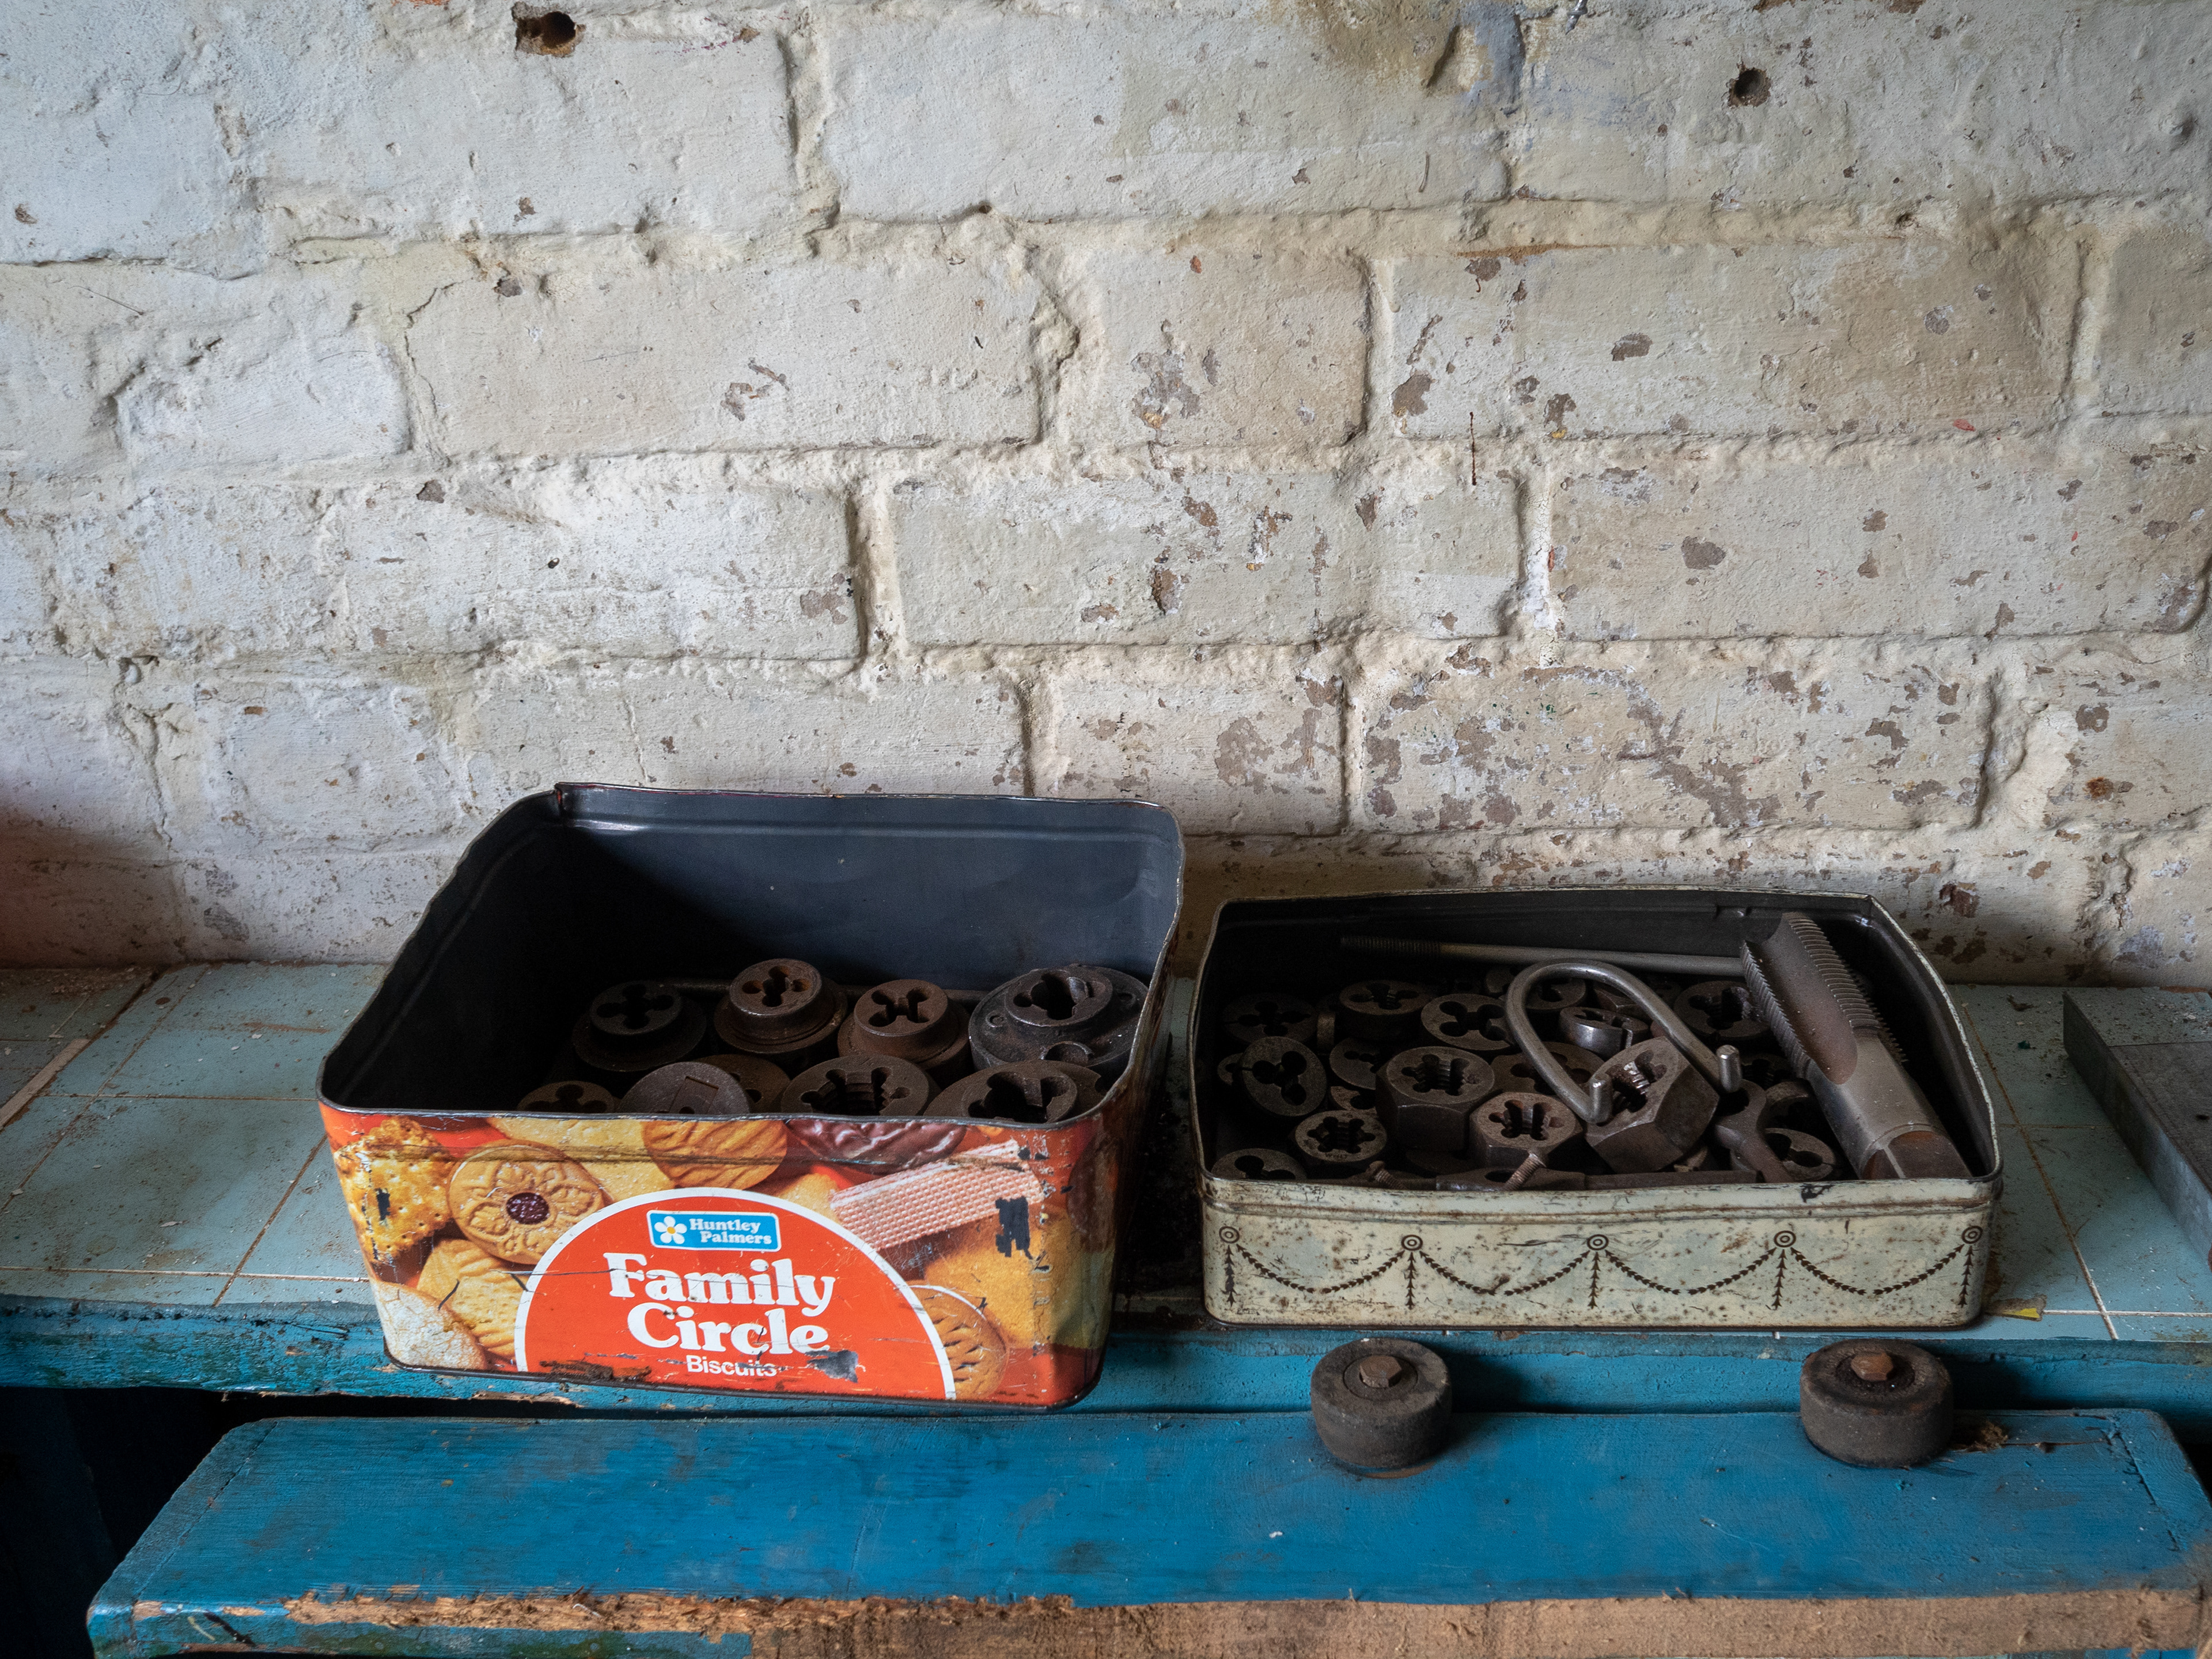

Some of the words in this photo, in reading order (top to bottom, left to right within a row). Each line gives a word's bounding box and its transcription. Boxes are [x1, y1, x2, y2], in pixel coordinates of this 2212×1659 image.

[689, 1218, 761, 1234] Huntley
[700, 1230, 772, 1245] Palmers
[603, 1252, 836, 1317] Family
[627, 1302, 831, 1355] Circle
[685, 1354, 778, 1377] Biscuits
